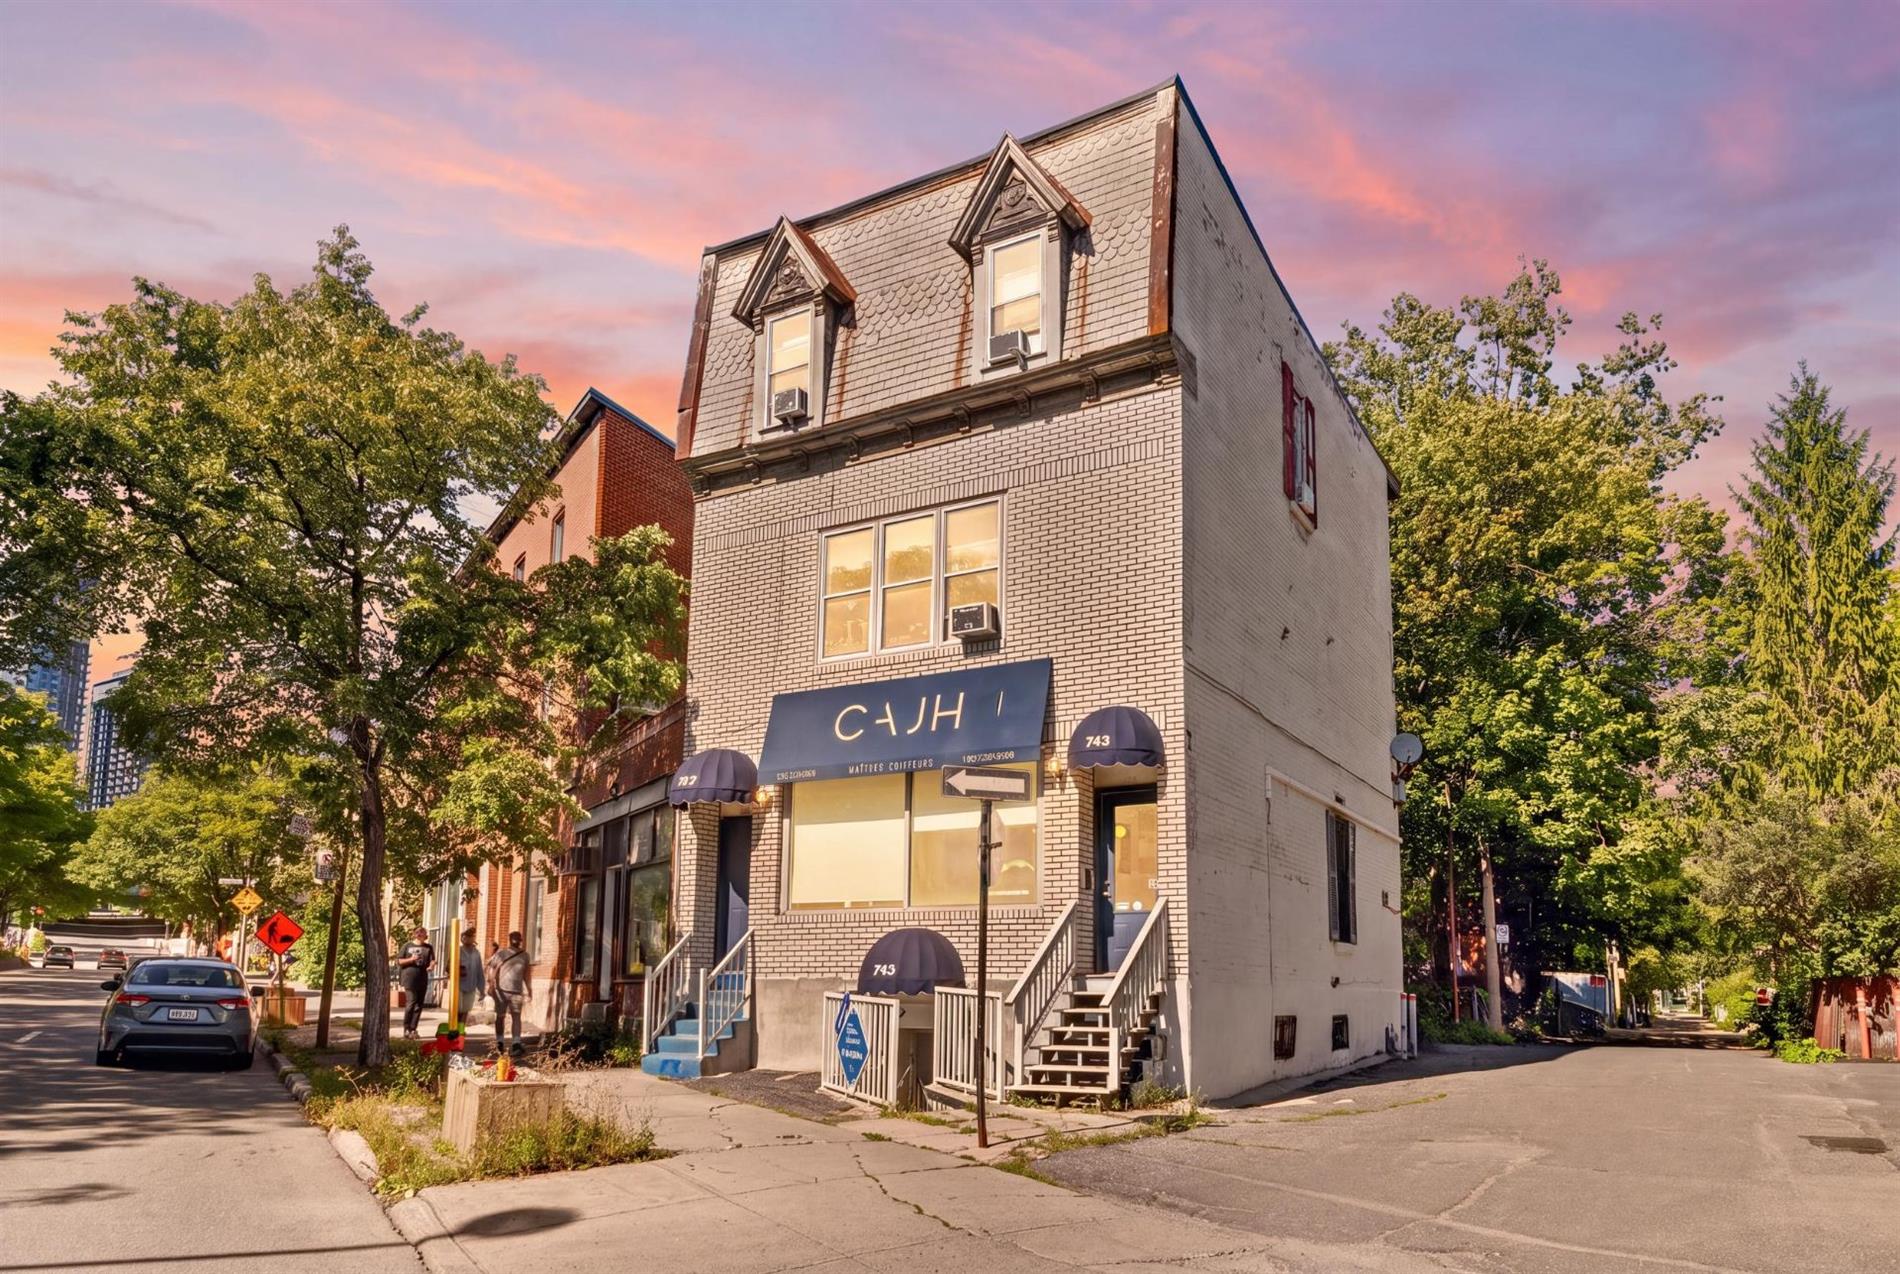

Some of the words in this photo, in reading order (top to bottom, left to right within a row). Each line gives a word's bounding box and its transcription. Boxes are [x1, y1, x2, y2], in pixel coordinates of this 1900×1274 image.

[1085, 735, 1110, 748] 743
[889, 758, 934, 771] COIFFEURS
[873, 964, 896, 976] 743
